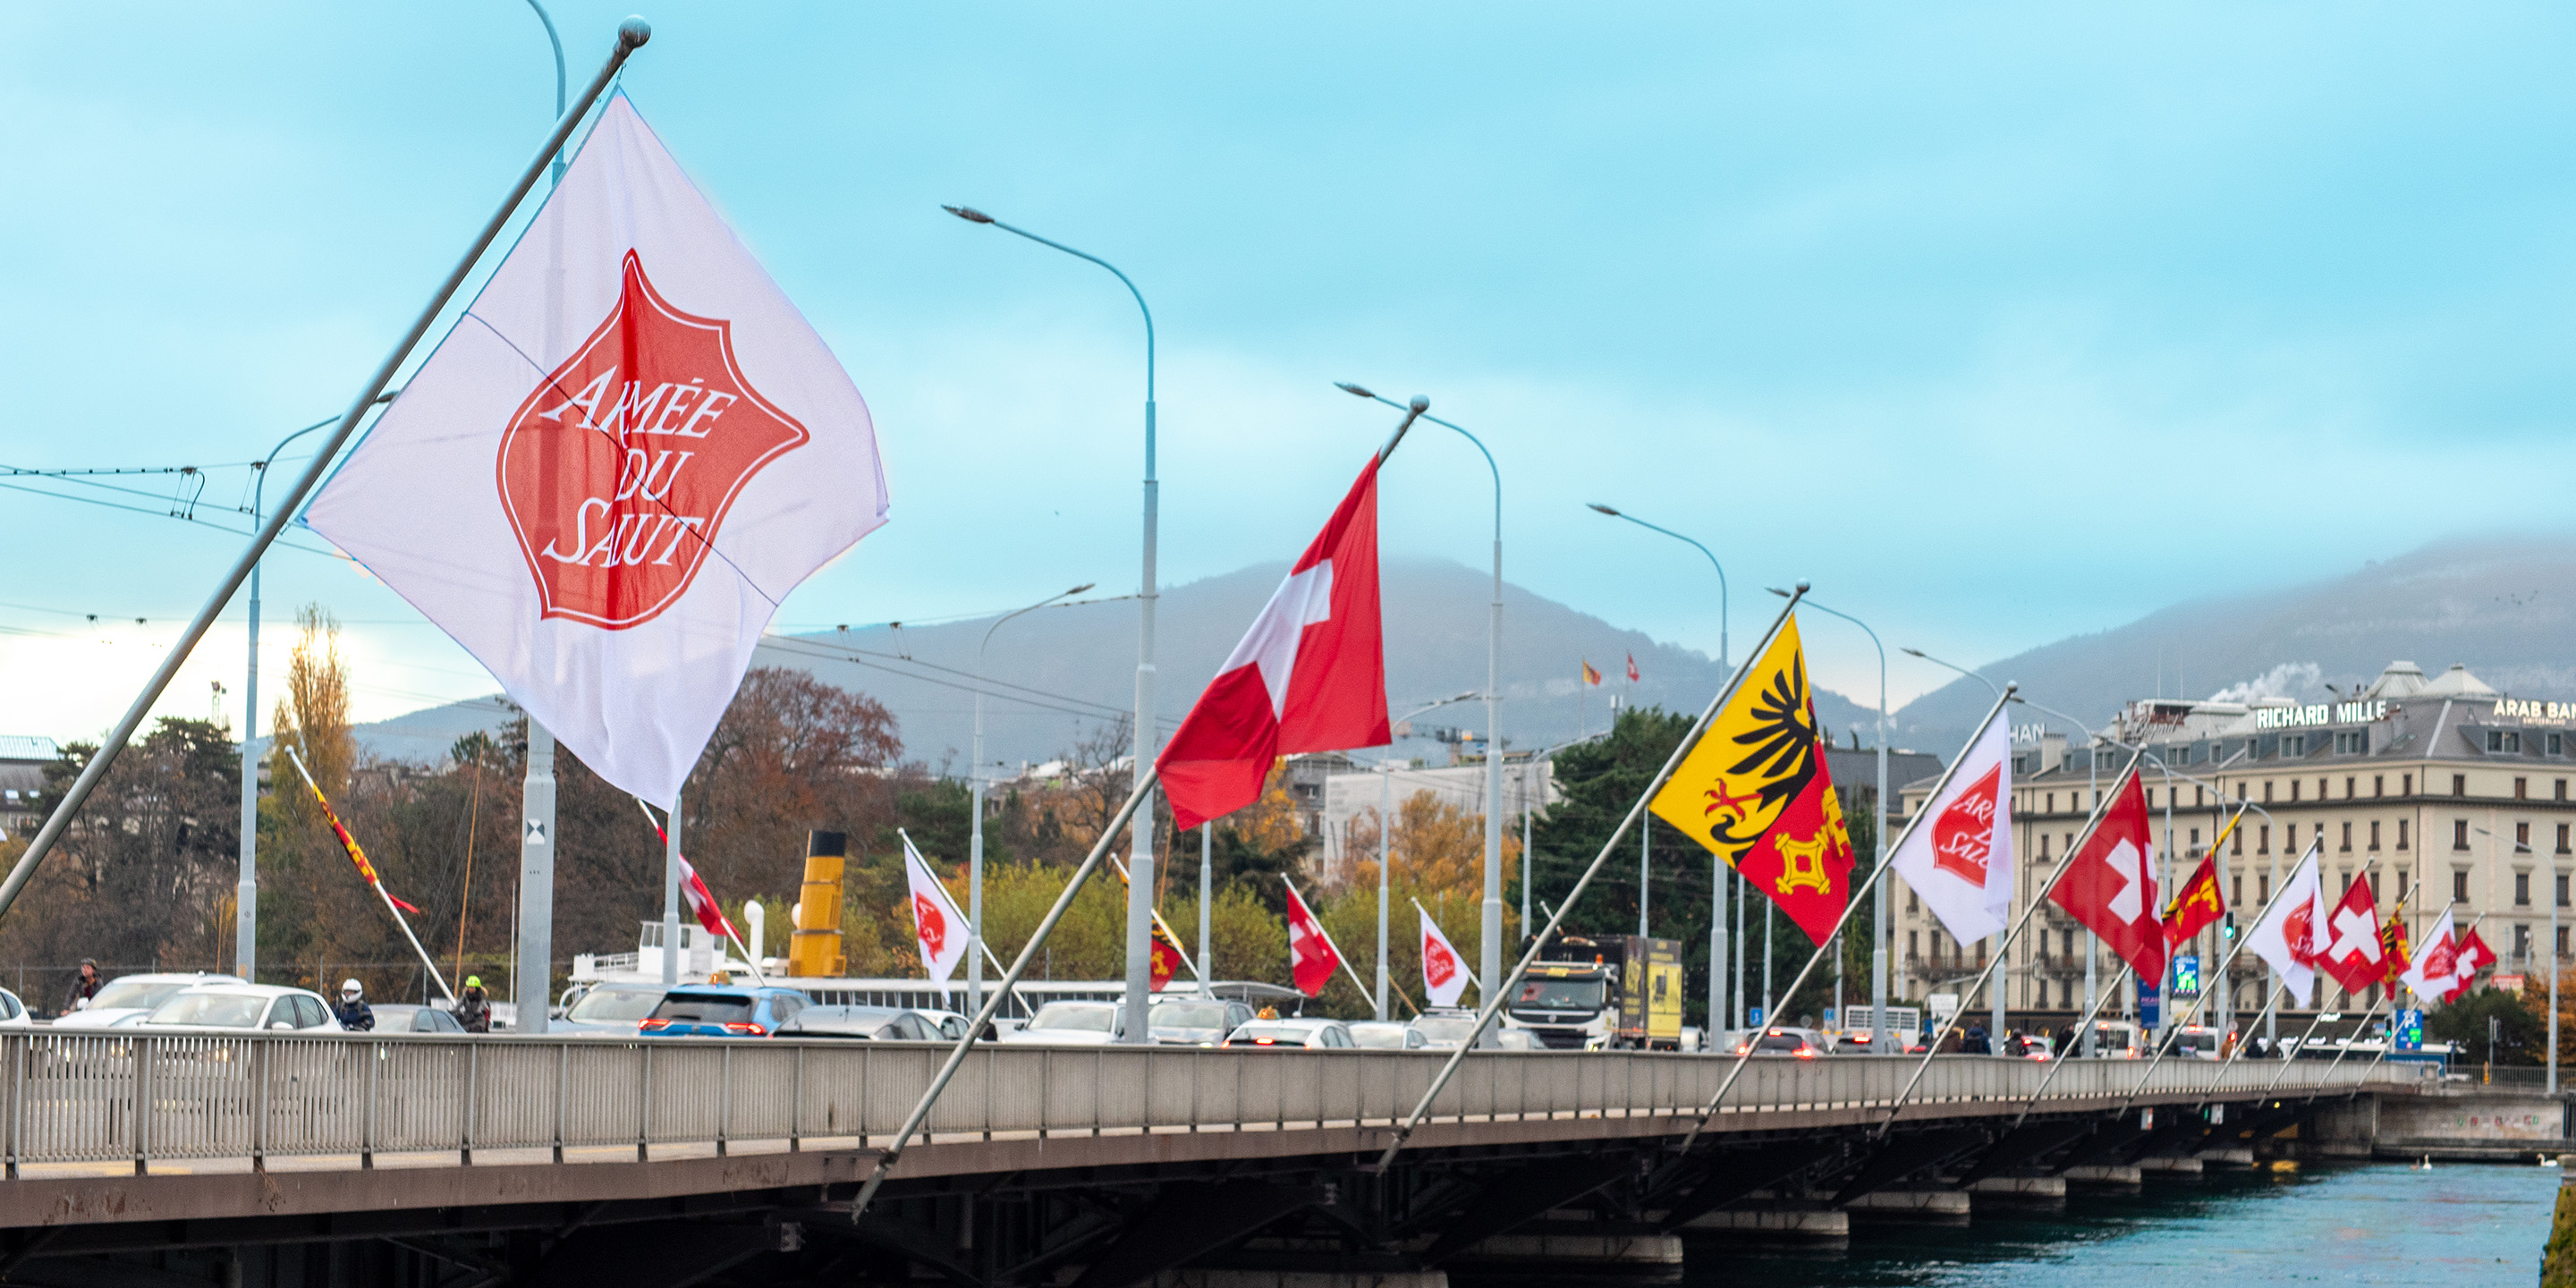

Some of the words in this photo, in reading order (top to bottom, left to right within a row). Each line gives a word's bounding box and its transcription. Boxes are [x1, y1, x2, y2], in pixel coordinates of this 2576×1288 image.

[614, 448, 694, 501] DU
[2257, 704, 2329, 729] RICHARD
[2336, 700, 2386, 724] MILLE
[2494, 699, 2541, 717] ARAB
